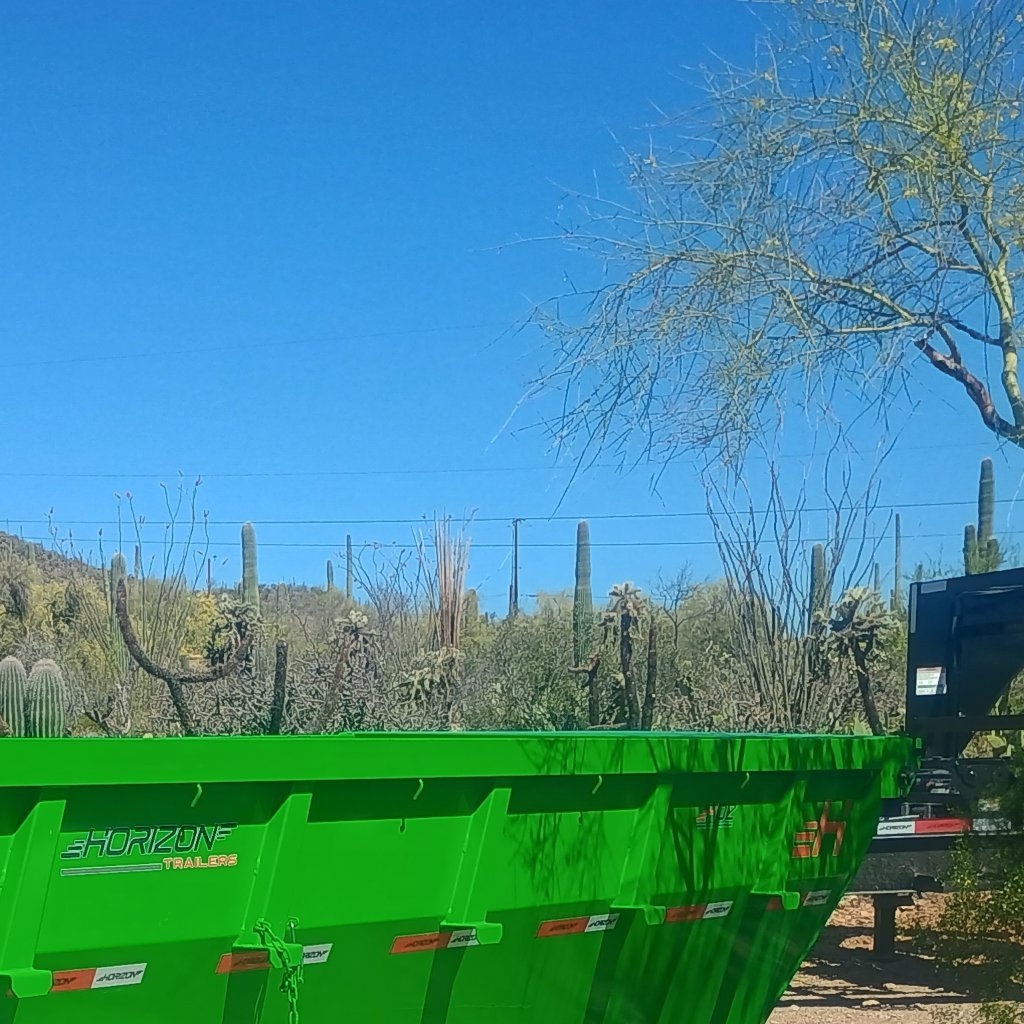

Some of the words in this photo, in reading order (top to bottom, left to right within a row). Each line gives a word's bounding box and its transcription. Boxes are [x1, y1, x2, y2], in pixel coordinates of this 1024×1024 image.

[61, 822, 238, 859] HORIZON
[163, 854, 238, 870] TRAILERS
[97, 970, 143, 982] HORIZON
